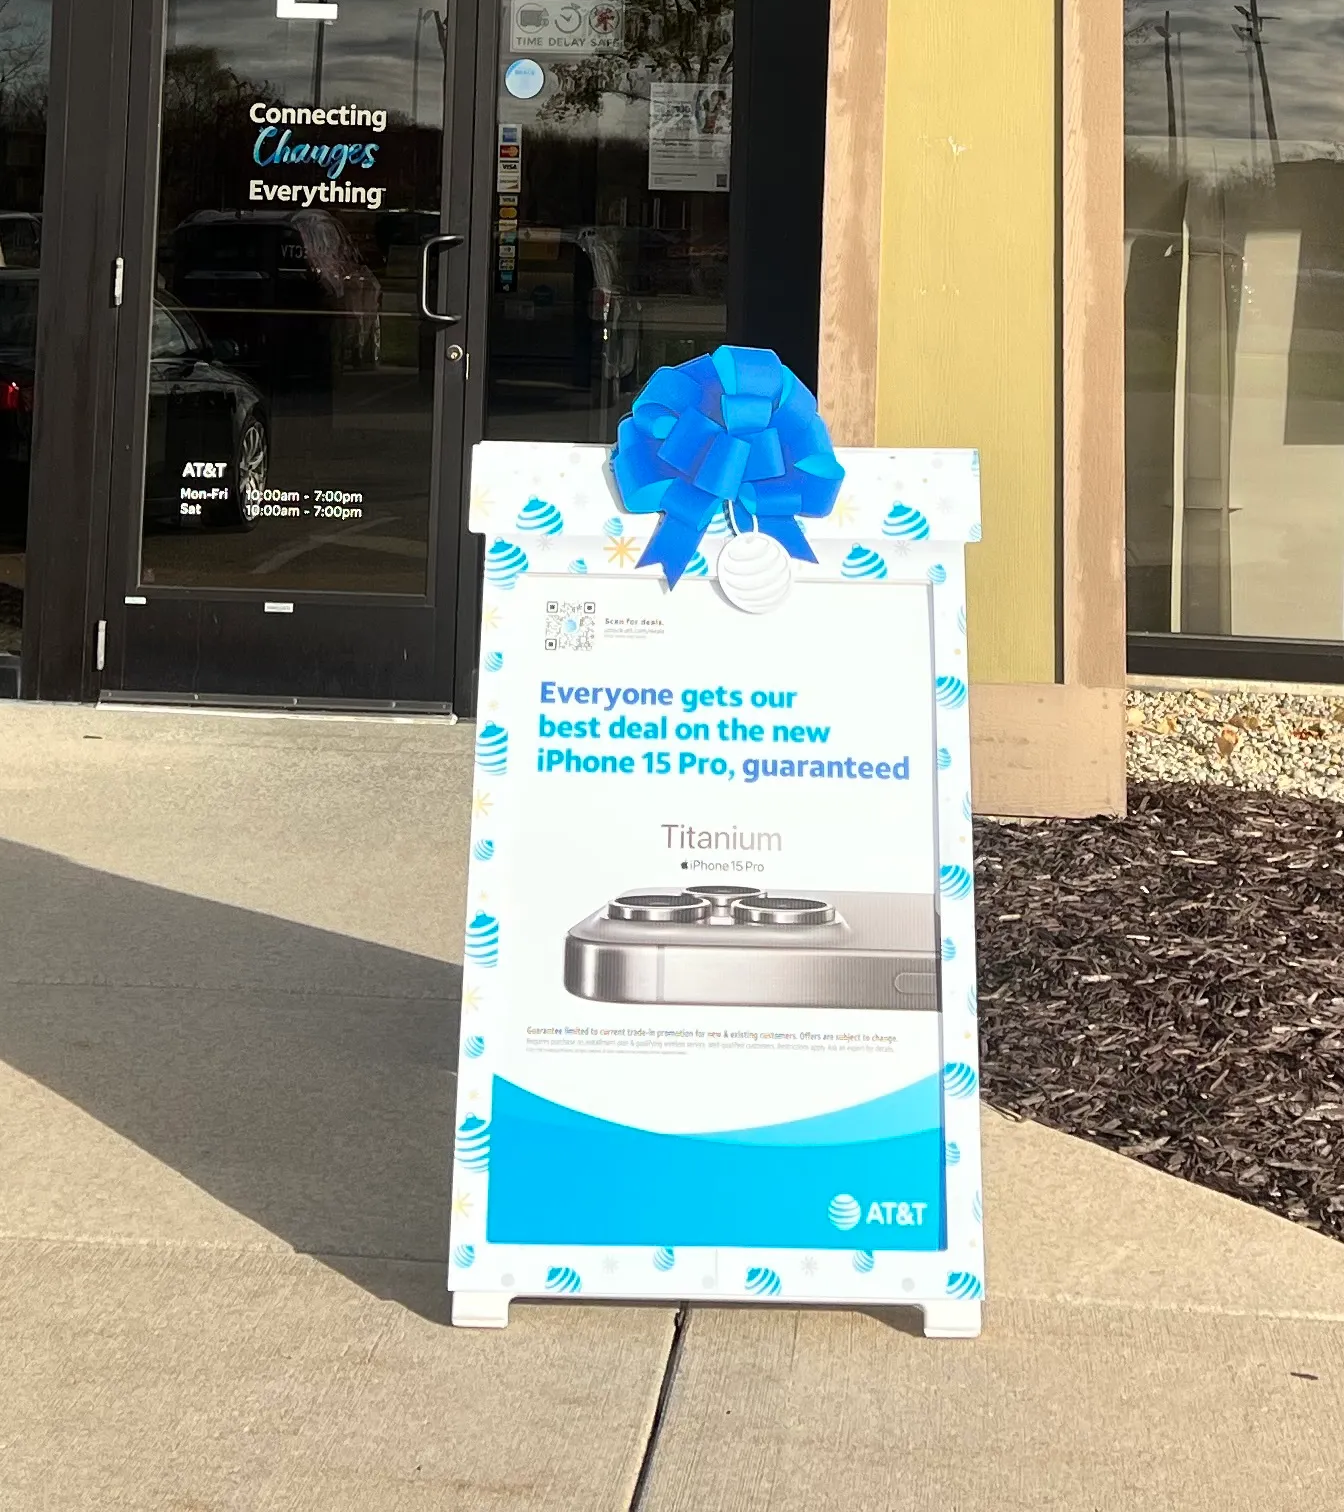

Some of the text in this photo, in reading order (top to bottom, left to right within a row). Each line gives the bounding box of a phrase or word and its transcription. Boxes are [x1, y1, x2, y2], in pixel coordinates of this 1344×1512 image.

[516, 37, 543, 47] TIME
[548, 38, 587, 48] DELAY
[249, 103, 387, 132] Connecting
[253, 126, 380, 179] Changes
[182, 462, 228, 478] AT&T
[180, 488, 229, 500] Mon-Fri
[245, 489, 300, 502] 10:00am
[313, 490, 363, 504] 7:00pm
[180, 503, 202, 516] Sat
[245, 504, 300, 517] 10:00am
[313, 505, 363, 520] 7:00pm
[540, 682, 798, 713] Everyone gets our
[538, 714, 831, 744] best deal on the new
[537, 749, 910, 784] iPhone 15 Pro, guaranteed
[661, 824, 783, 851] Titanium
[690, 860, 765, 872] iPhone 15 Pro
[527, 1027, 563, 1036] Guarantee
[564, 1027, 590, 1036] limited
[731, 1030, 758, 1040] existing
[799, 1032, 822, 1040] Offers
[866, 1201, 928, 1227] AT&T
